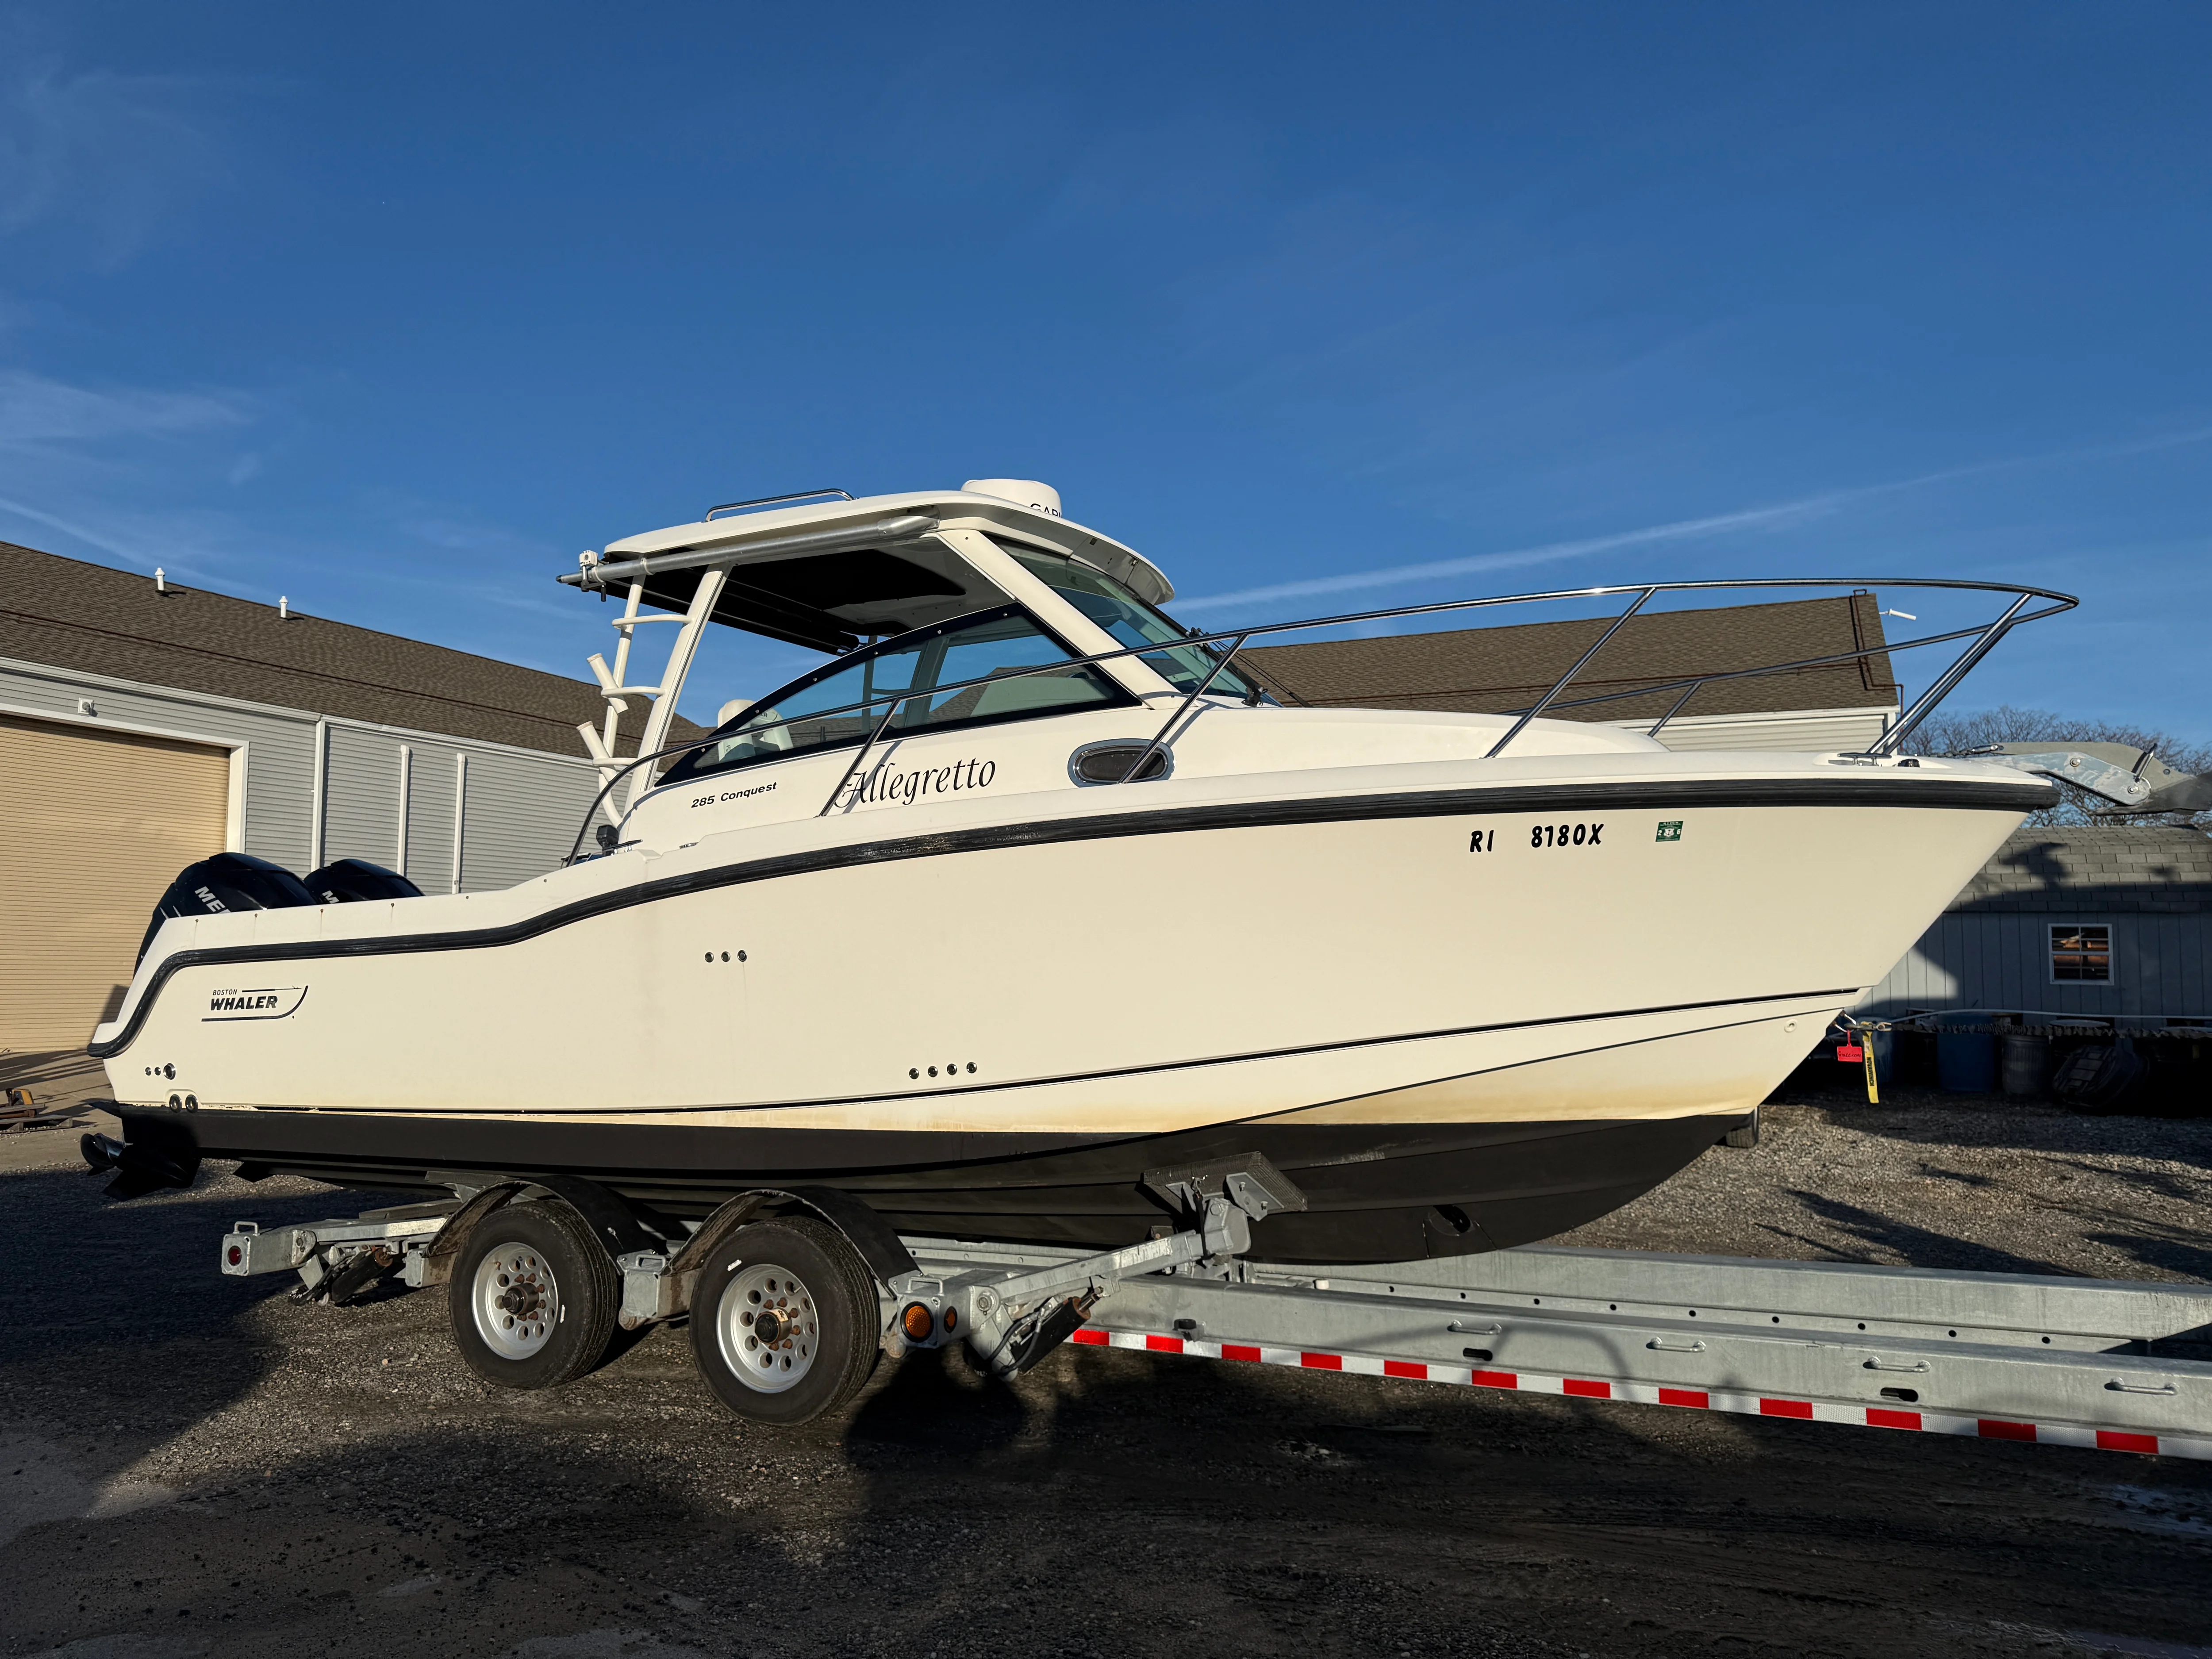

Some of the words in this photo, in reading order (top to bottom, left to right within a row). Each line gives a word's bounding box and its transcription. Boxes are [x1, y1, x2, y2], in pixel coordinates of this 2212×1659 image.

[691, 795, 715, 808] 285
[721, 782, 777, 802] Conquest
[834, 757, 996, 808] Allegretto
[1470, 830, 1494, 853] RI
[1531, 823, 1604, 848] 8180X
[211, 995, 278, 1011] WHALER
